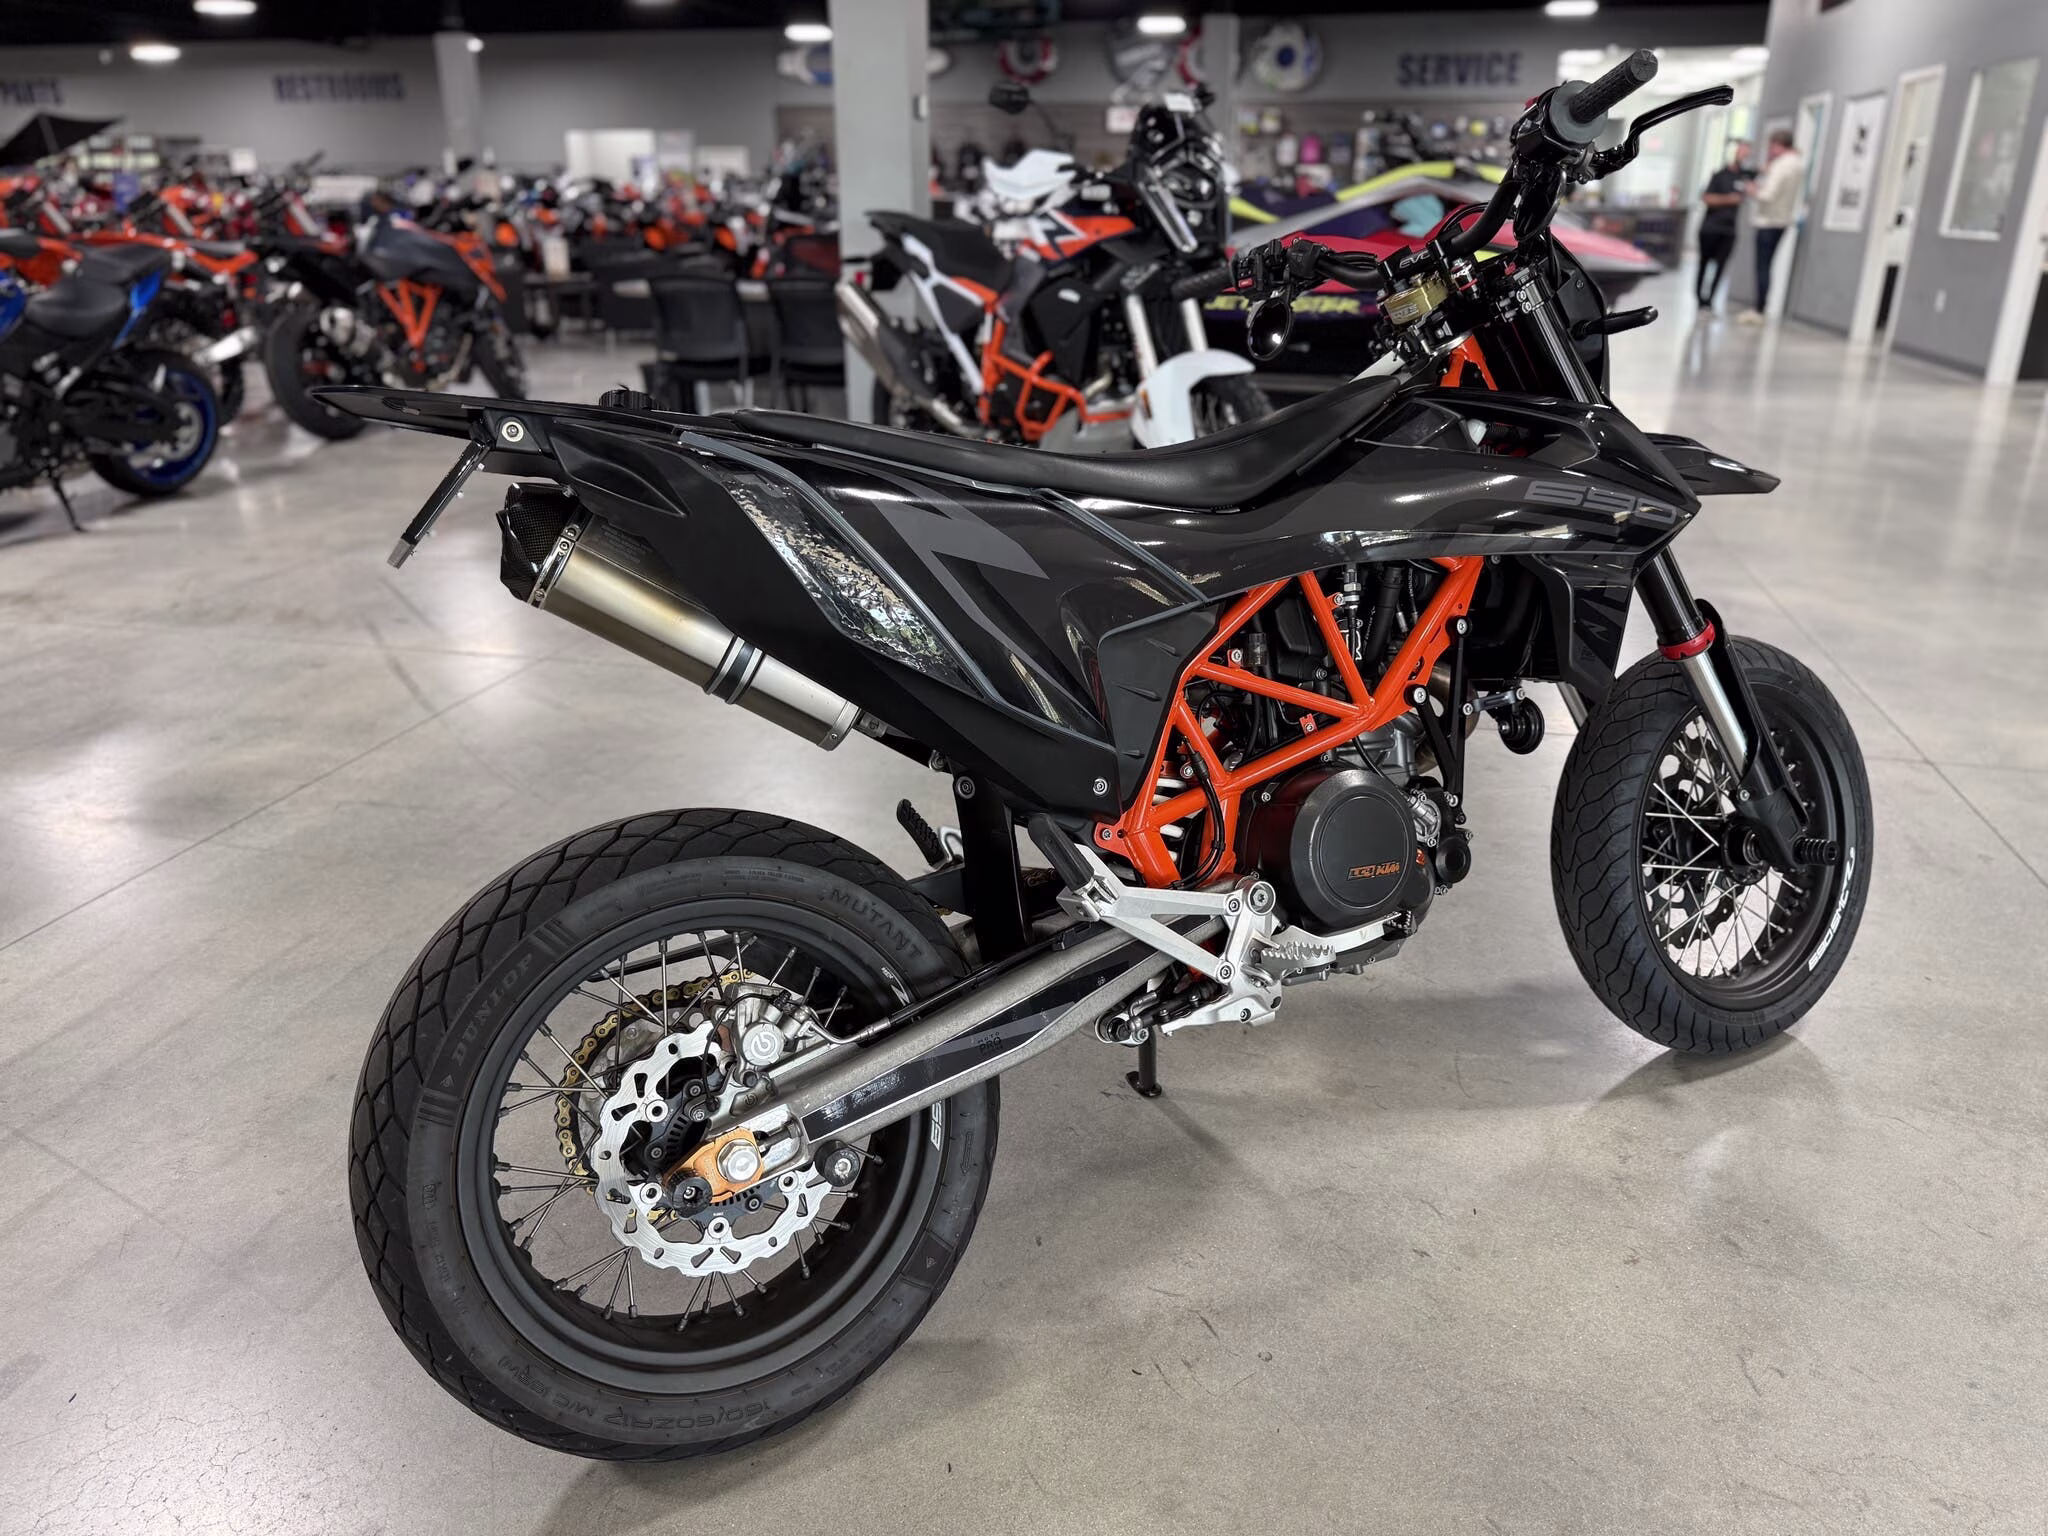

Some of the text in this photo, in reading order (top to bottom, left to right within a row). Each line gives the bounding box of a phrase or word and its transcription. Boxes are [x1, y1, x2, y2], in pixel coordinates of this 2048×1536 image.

[1398, 51, 1523, 88] SERVICE
[830, 888, 922, 958] MUTANT
[451, 953, 533, 1067] DUNLOP
